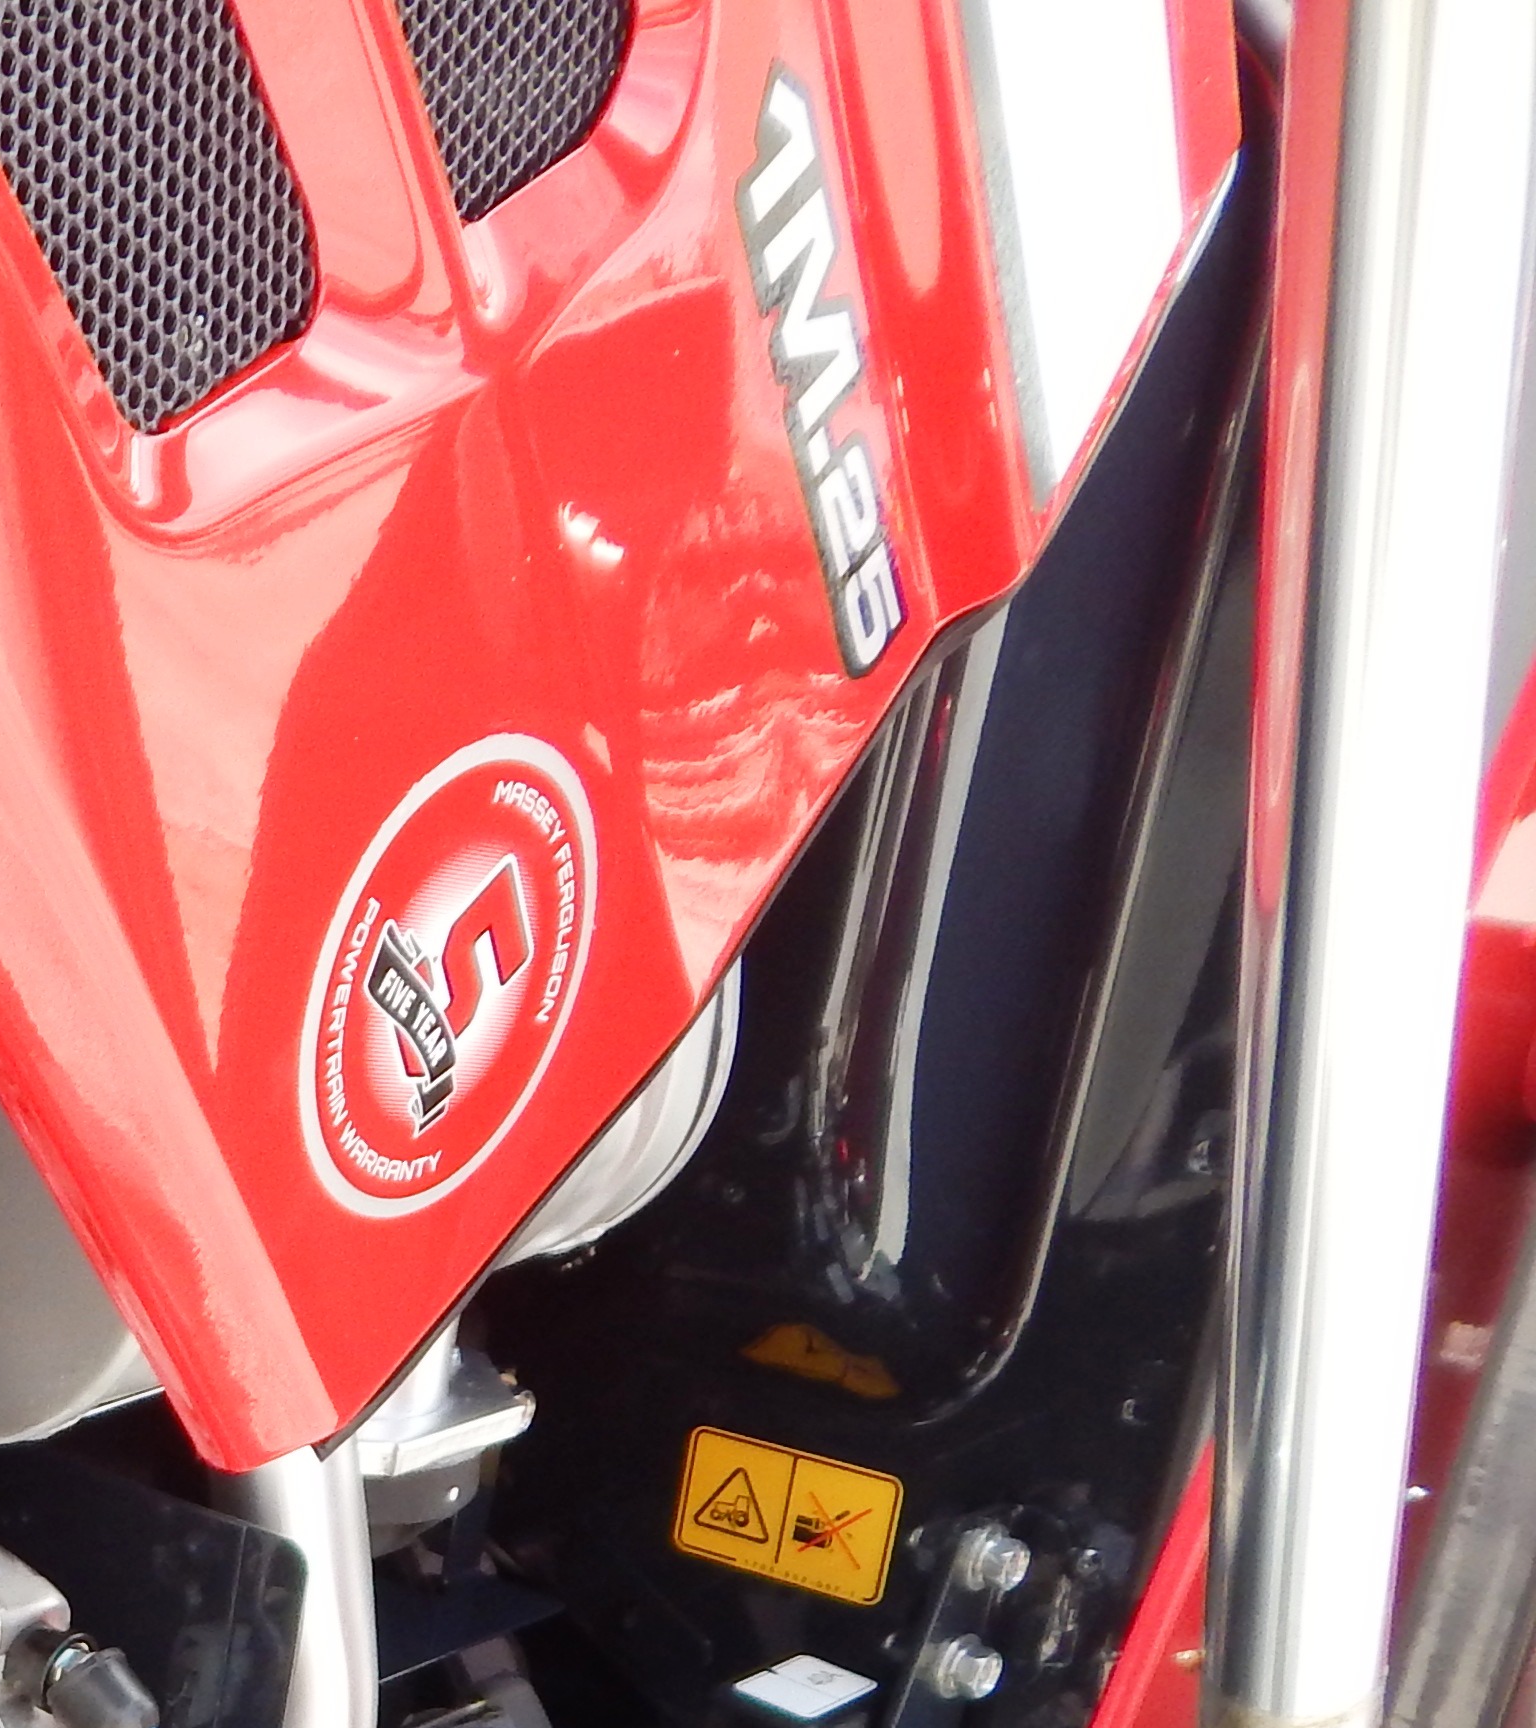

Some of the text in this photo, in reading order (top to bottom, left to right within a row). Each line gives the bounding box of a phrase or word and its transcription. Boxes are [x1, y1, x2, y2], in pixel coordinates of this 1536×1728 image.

[378, 966, 448, 1067] FIVE YEAR
[491, 779, 576, 1024] MASSEY FERGUSON
[325, 896, 442, 1183] POWERTRAIN WARRANTY
